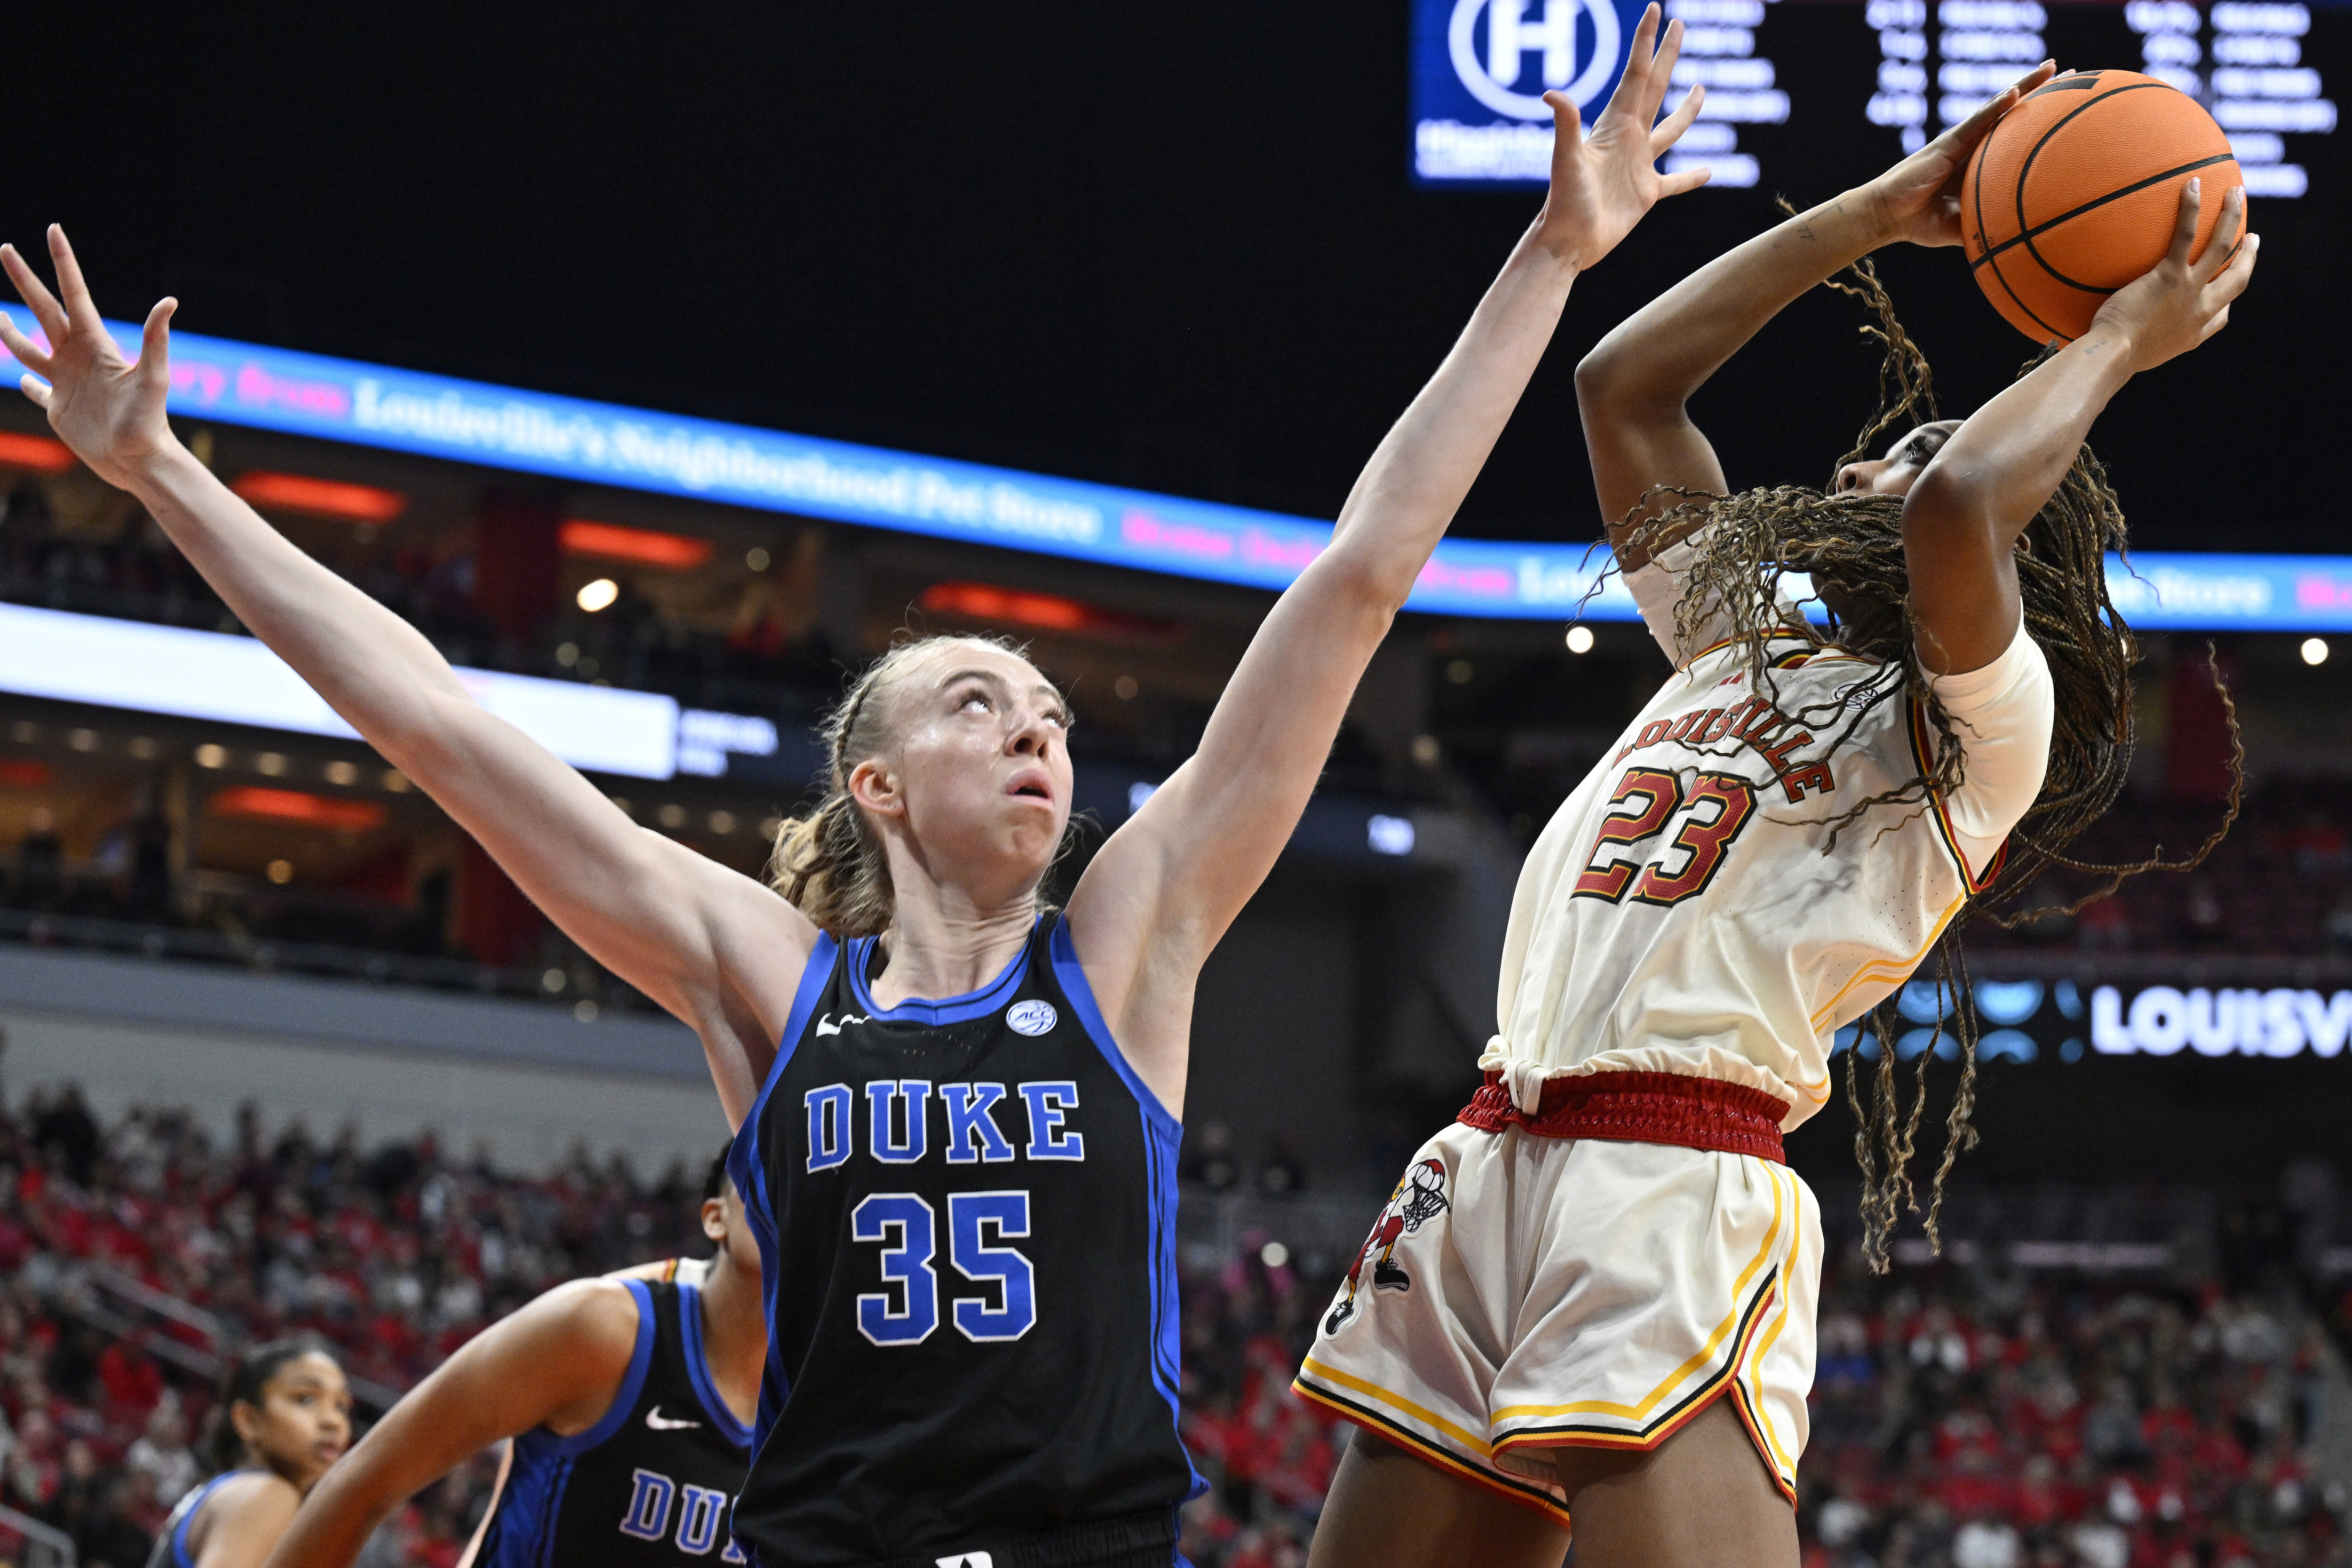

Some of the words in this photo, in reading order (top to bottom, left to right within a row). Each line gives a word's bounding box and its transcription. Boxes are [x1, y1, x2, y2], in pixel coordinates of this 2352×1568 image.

[1570, 766, 1758, 908] 23
[804, 1079, 1085, 1174] DUKE
[851, 1190, 1037, 1347] 35
